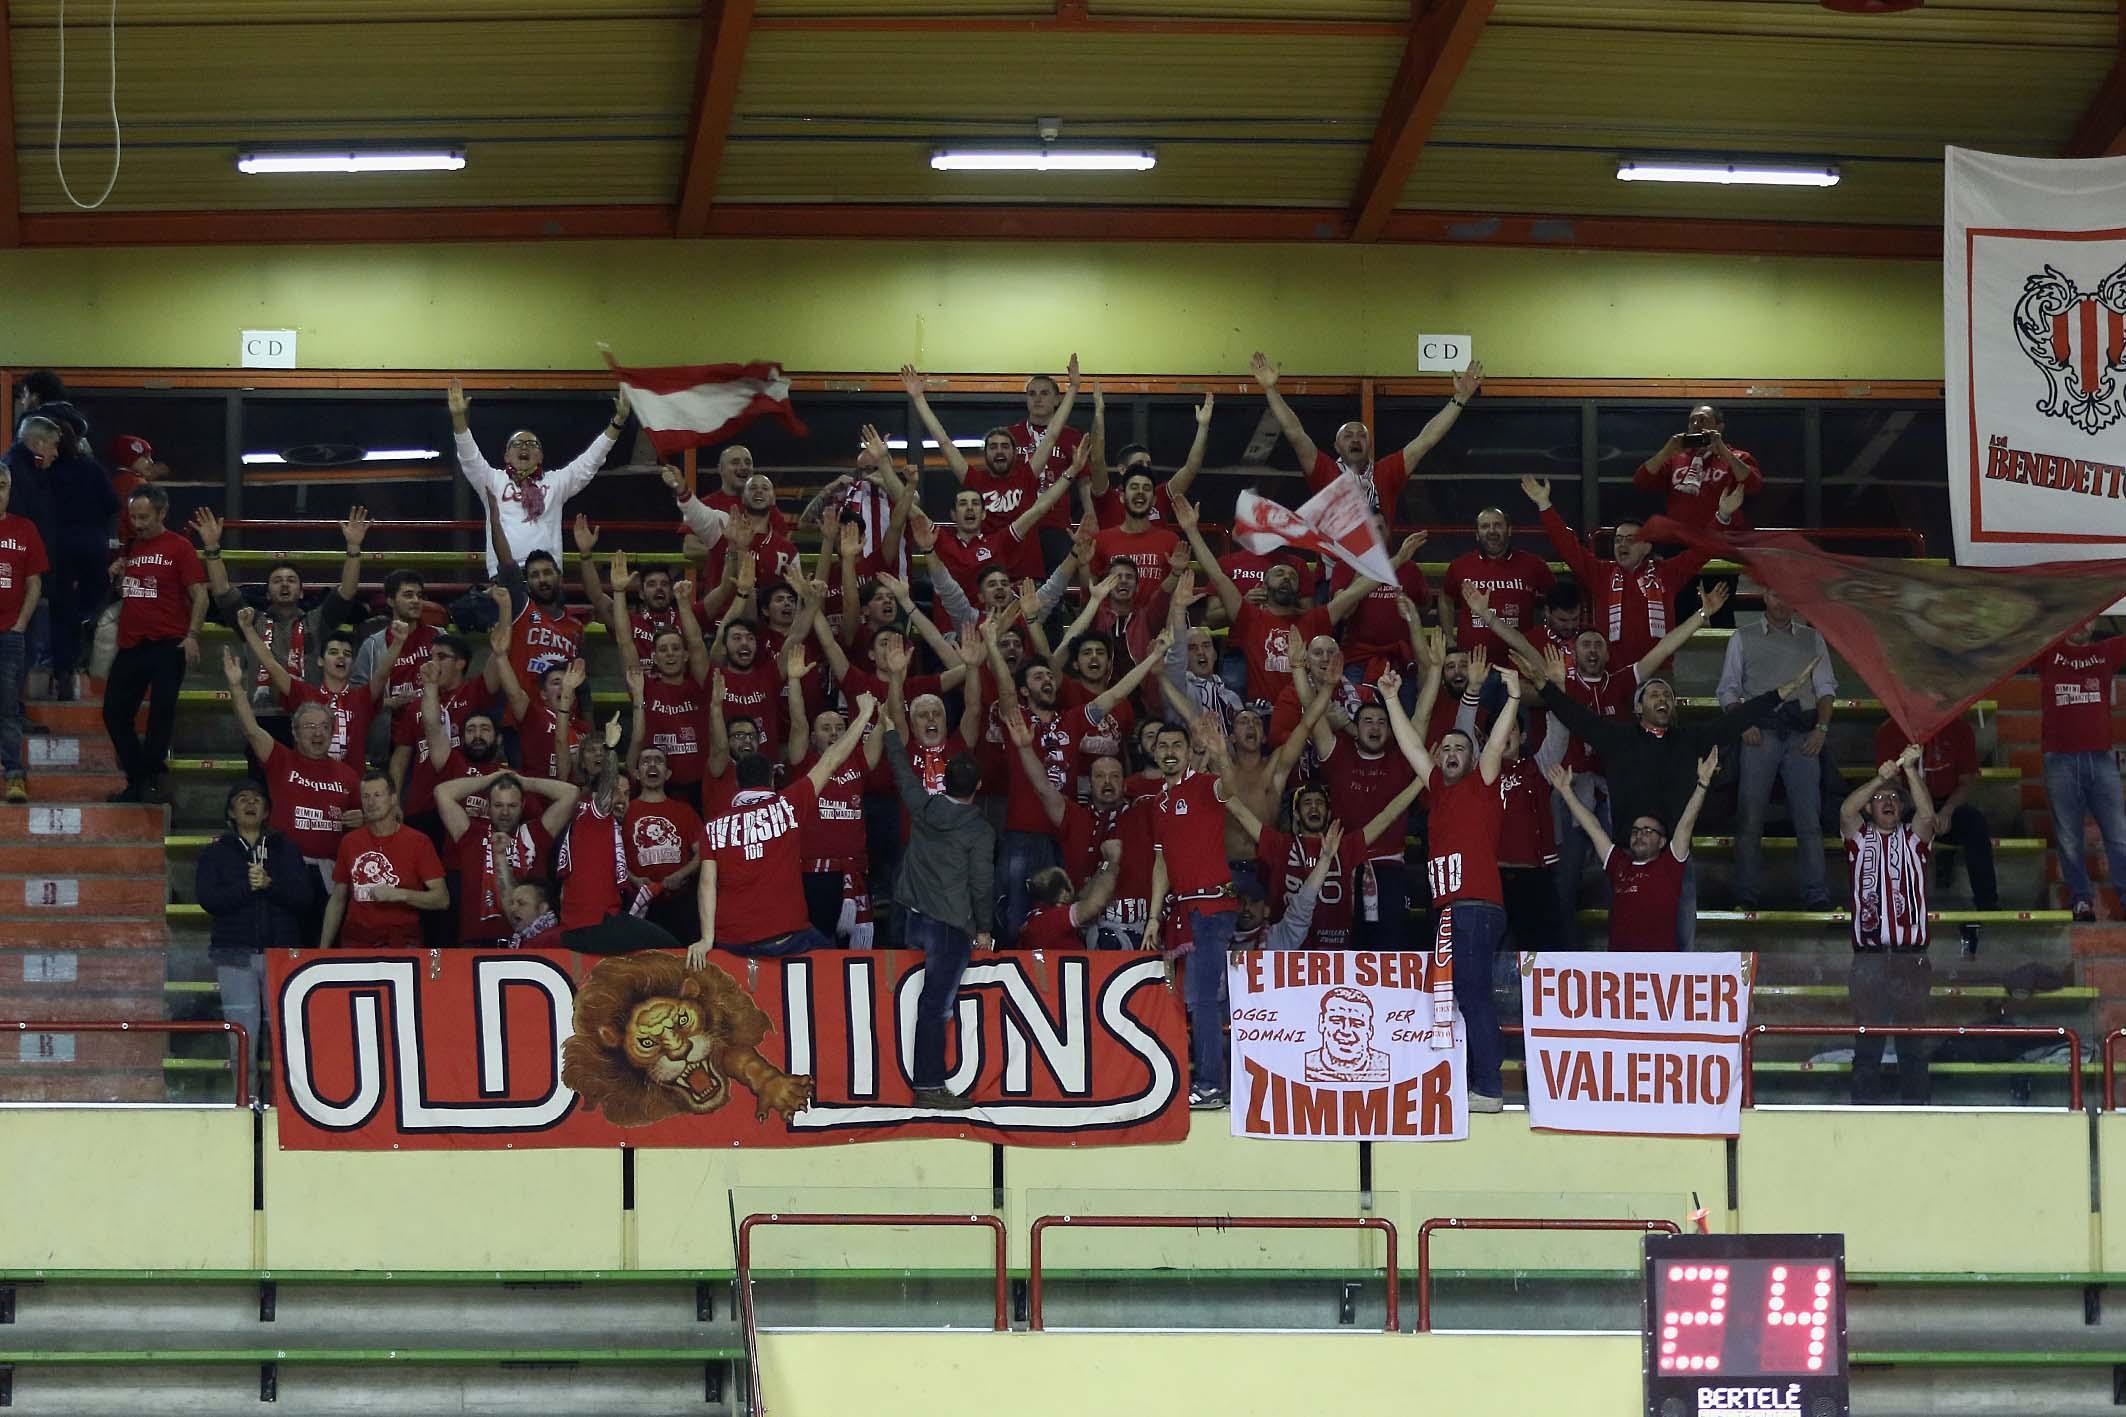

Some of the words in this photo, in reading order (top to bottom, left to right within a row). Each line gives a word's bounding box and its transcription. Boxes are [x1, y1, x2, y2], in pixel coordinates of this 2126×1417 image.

[1985, 446, 2126, 499] BENEDETT
[127, 553, 163, 568] squali
[1233, 568, 1265, 582] Pasq
[288, 769, 344, 795] Pasquali
[1273, 951, 1345, 989] IERI
[1532, 967, 1739, 1023] FOREVER
[1232, 1008, 1279, 1022] OGGI
[1385, 1009, 1416, 1024] PER
[279, 957, 577, 1134] OLD
[781, 957, 1181, 1133] LIONS
[1237, 1028, 1307, 1043] DOMANI
[1244, 1055, 1454, 1137] ZIMMER
[1539, 1050, 1732, 1105] VALERIO
